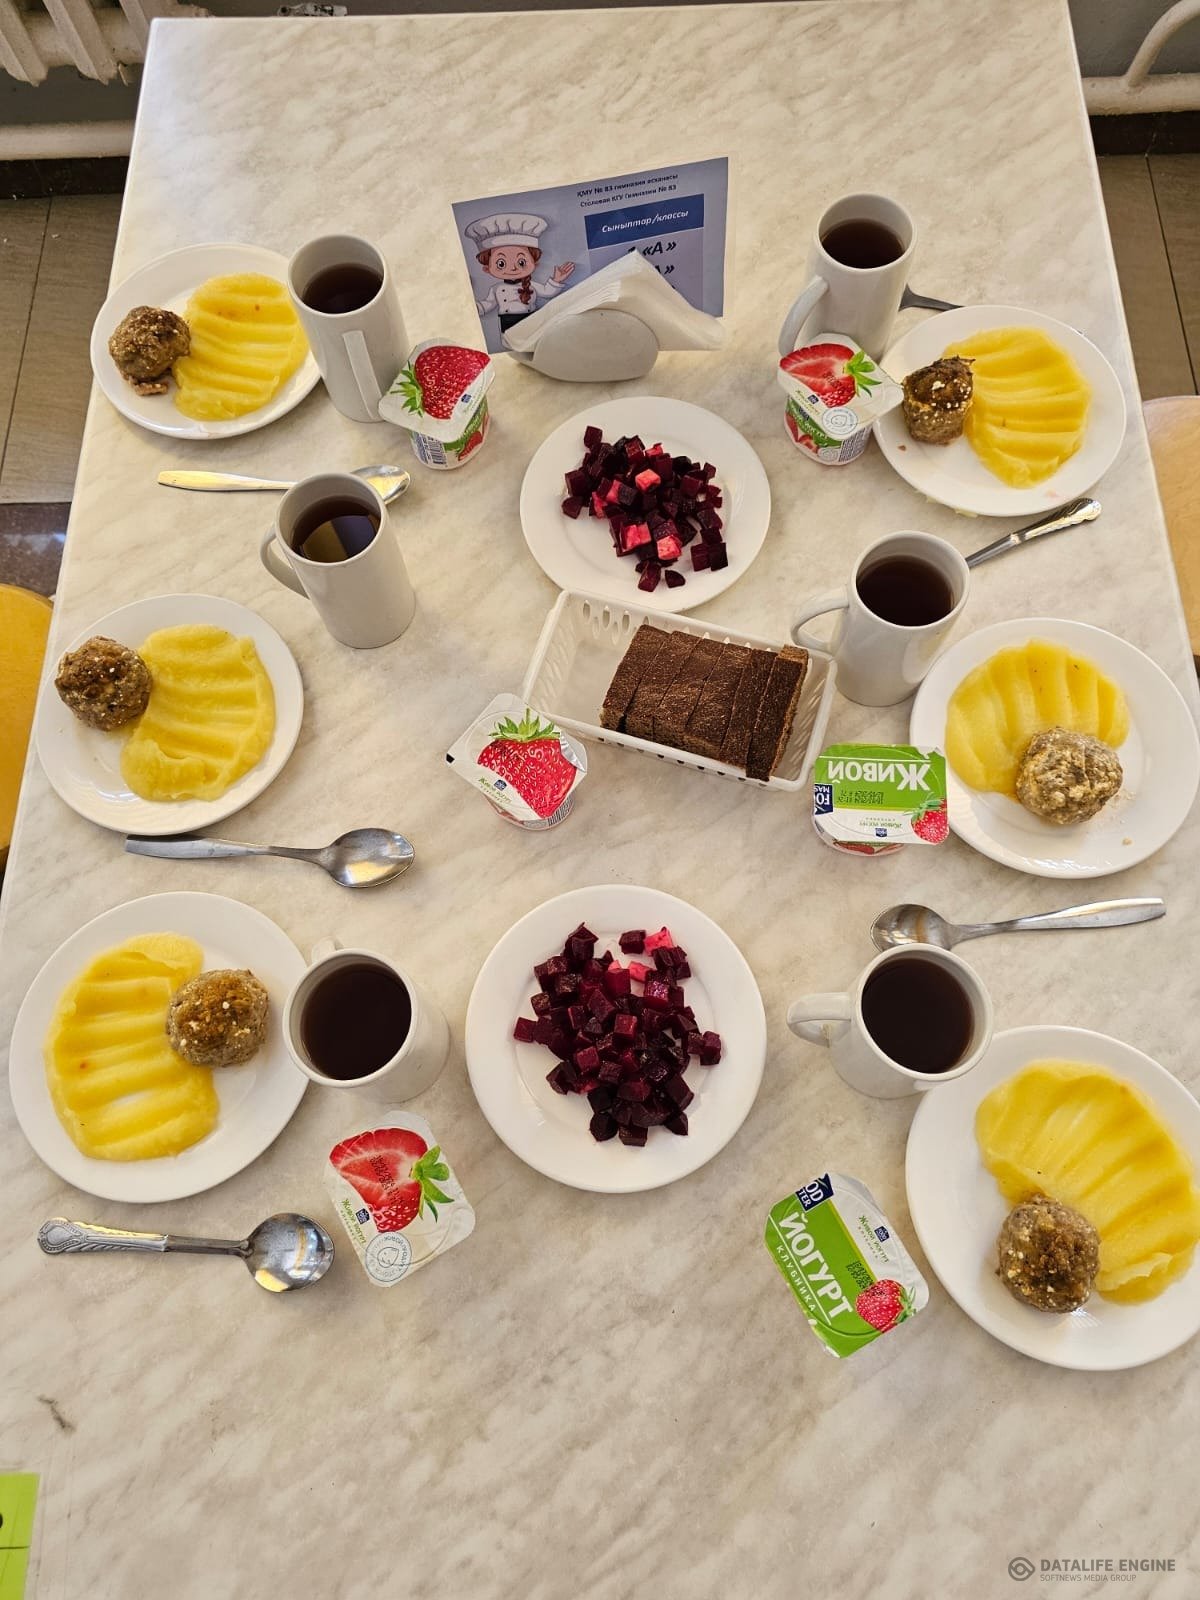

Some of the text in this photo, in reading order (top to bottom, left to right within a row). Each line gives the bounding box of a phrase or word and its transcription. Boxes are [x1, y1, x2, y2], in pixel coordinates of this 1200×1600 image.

[614, 180, 646, 190] гимназия
[601, 210, 689, 233] Сыныптар/классы
[814, 792, 831, 805] FO
[778, 1211, 853, 1318] ЙОГУРТ
[776, 1245, 816, 1312] КЛУБНИКА
